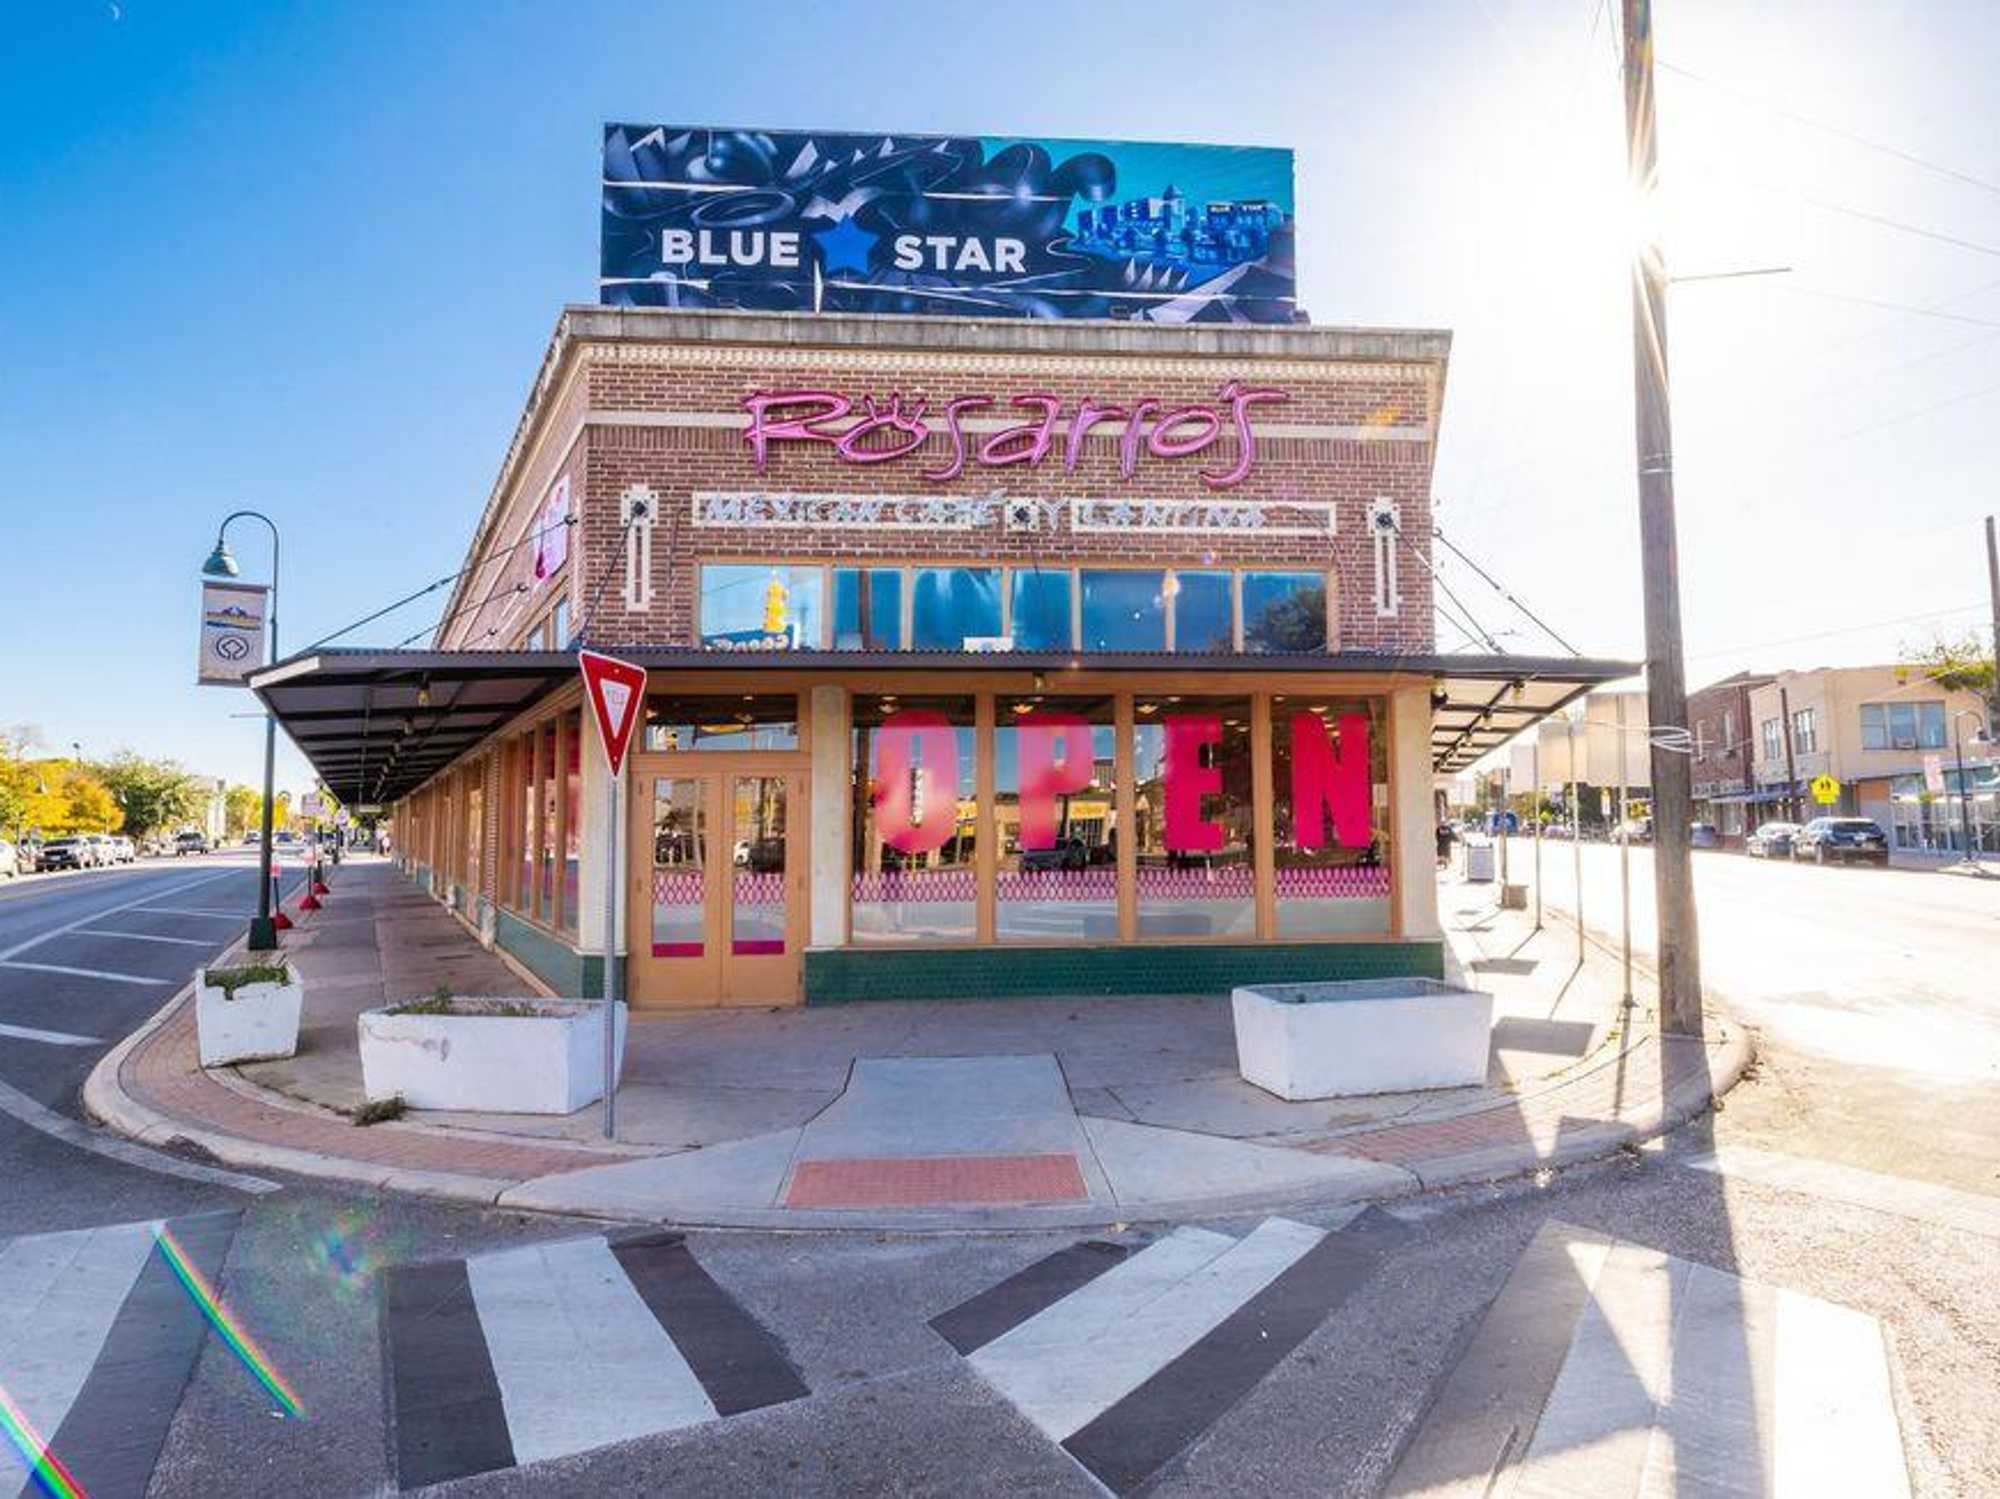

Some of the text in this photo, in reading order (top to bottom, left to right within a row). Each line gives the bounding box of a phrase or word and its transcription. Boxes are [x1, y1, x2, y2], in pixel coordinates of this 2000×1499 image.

[661, 229, 1026, 273] BLUE STAR
[876, 712, 1372, 852] OPEN
